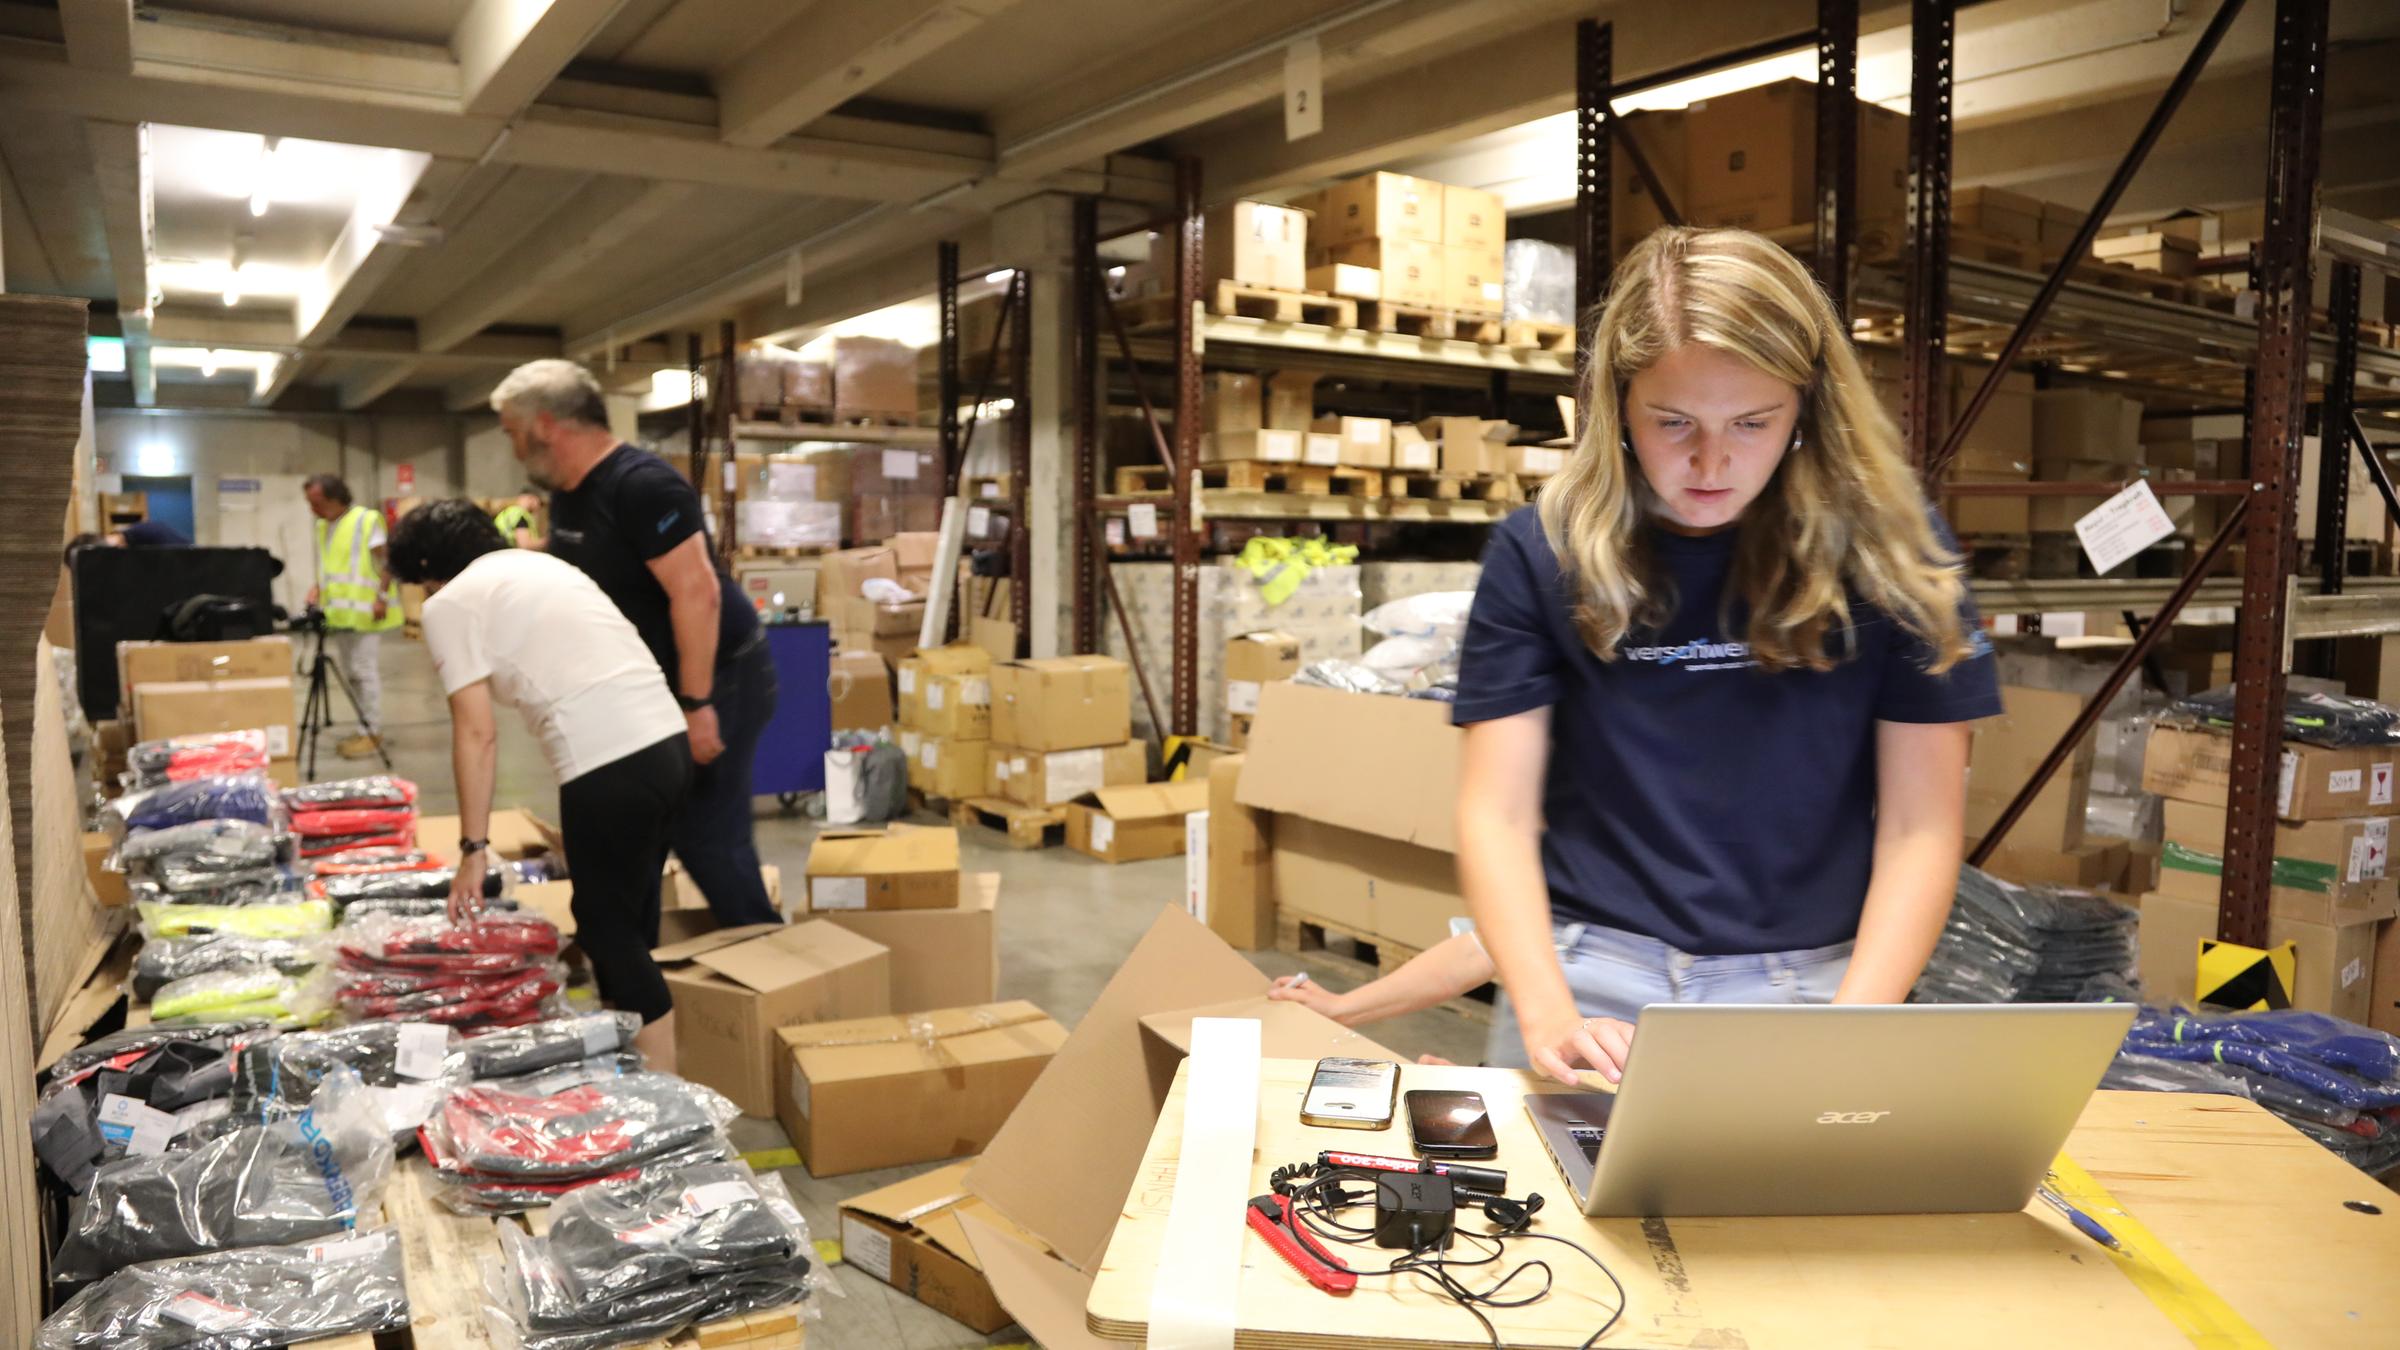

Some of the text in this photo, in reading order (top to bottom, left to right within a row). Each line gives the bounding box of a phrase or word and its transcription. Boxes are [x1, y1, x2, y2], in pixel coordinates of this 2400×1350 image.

[1296, 90, 1308, 114] 2
[1816, 1111, 1891, 1124] acer
[1340, 1155, 1373, 1167] 300
[1410, 1182, 1423, 1203] acer
